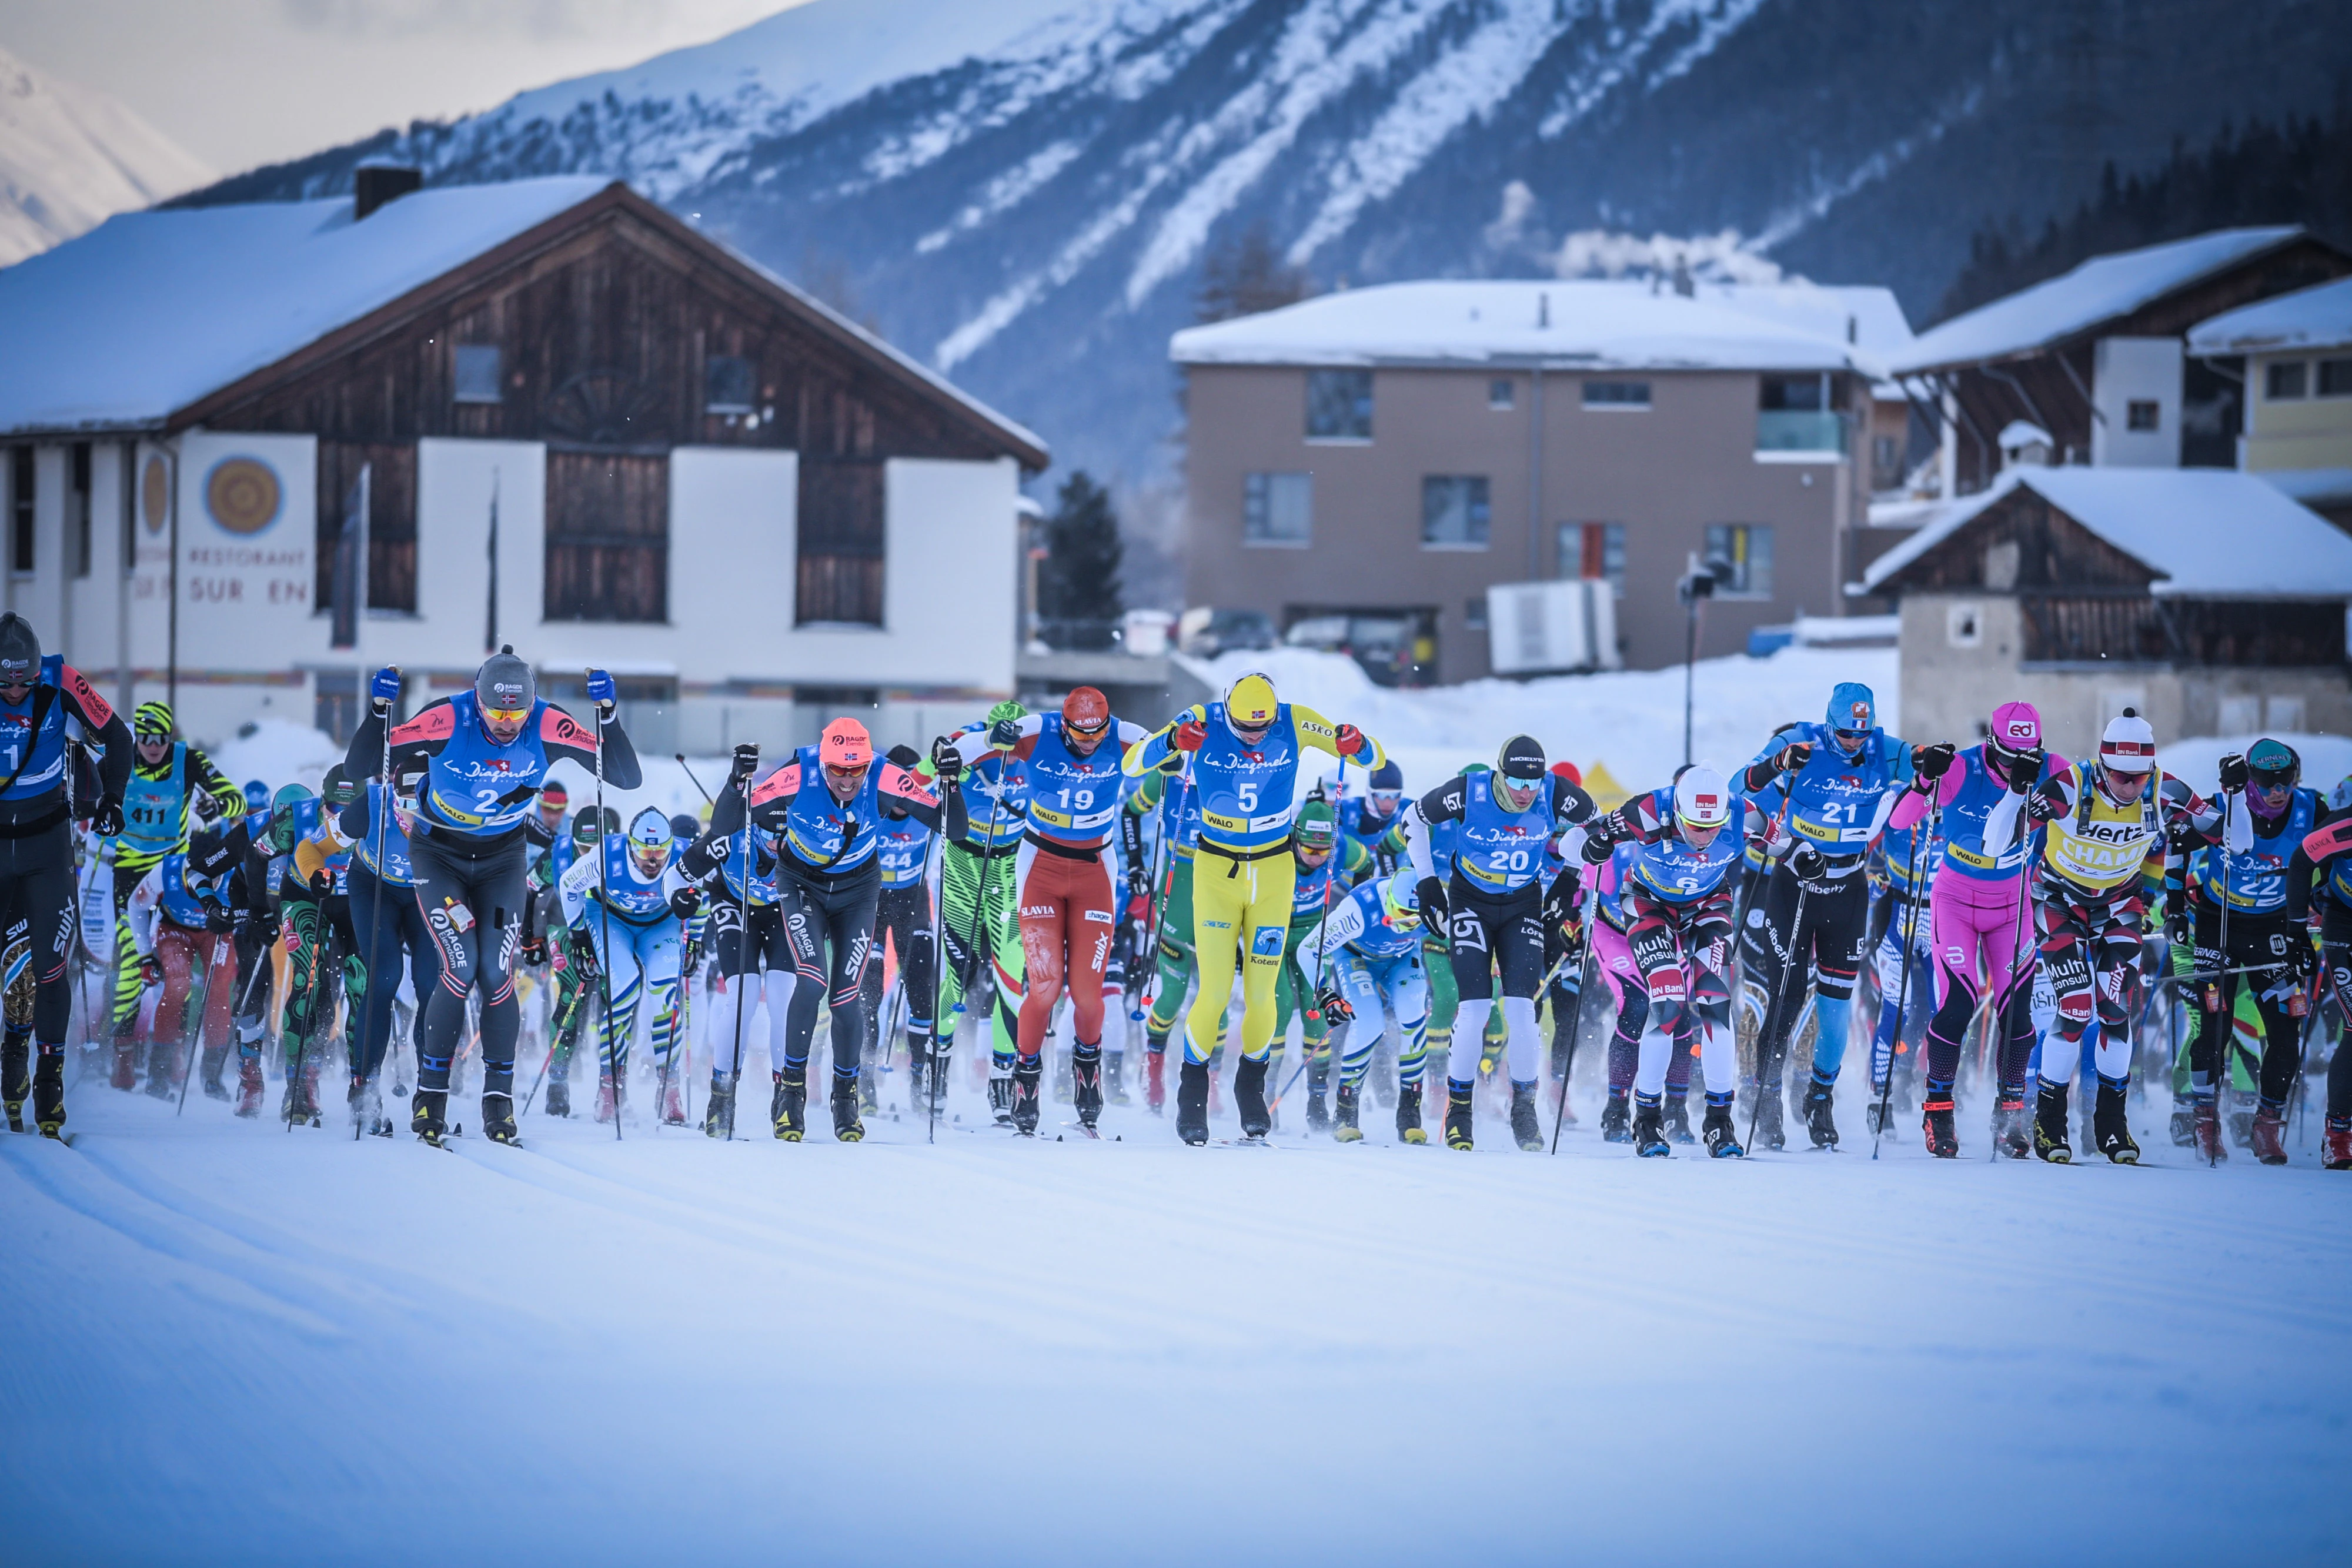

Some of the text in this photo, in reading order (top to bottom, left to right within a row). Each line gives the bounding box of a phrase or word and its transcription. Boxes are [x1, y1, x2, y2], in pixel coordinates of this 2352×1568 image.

[188, 548, 305, 566] RESTORANT
[189, 577, 244, 603] SUR
[268, 578, 306, 604] EN
[88, 690, 110, 716] RAGDE
[1074, 717, 1102, 726] SLAVIA
[1301, 721, 1334, 737] ASKO
[3, 744, 18, 770] 1
[1204, 749, 1292, 774] La Diagonela
[2257, 755, 2287, 764] SERNEKE
[443, 760, 539, 783] La Diagonela
[1035, 760, 1119, 783] La Diagonela
[1822, 778, 1885, 796] Diagonela
[473, 789, 499, 813] 2
[1057, 788, 1094, 810] 19
[1238, 783, 1258, 813] 5
[1442, 791, 1463, 813] 157
[1561, 795, 1578, 813] 157
[131, 807, 165, 825] 411
[439, 800, 466, 821] WALO
[1035, 807, 1058, 822] WALO
[1822, 802, 1857, 823] 21
[1957, 804, 1976, 817] La
[1207, 814, 1233, 828] WALO
[1799, 822, 1825, 838] WALO
[1466, 824, 1552, 845] La Diagonela
[706, 835, 731, 860] 157
[794, 838, 816, 859] WALO
[822, 838, 841, 853] 4
[880, 853, 912, 868] 44
[1488, 850, 1529, 871] 20
[1956, 849, 1982, 865] WALO
[1468, 864, 1492, 880] WALO
[1676, 877, 1698, 890] 6
[2239, 876, 2281, 895] 22
[1021, 905, 1055, 917] SLAVIA
[1452, 907, 1487, 953] 157
[438, 932, 456, 969] Eiendom
[445, 928, 467, 968] RAGDE
[791, 930, 807, 960] Eiendom
[797, 927, 816, 958] RAGDE
[1652, 984, 1685, 995] BN Bank
[2054, 974, 2089, 991] consult
[2038, 1079, 2055, 1090] OVENTO
